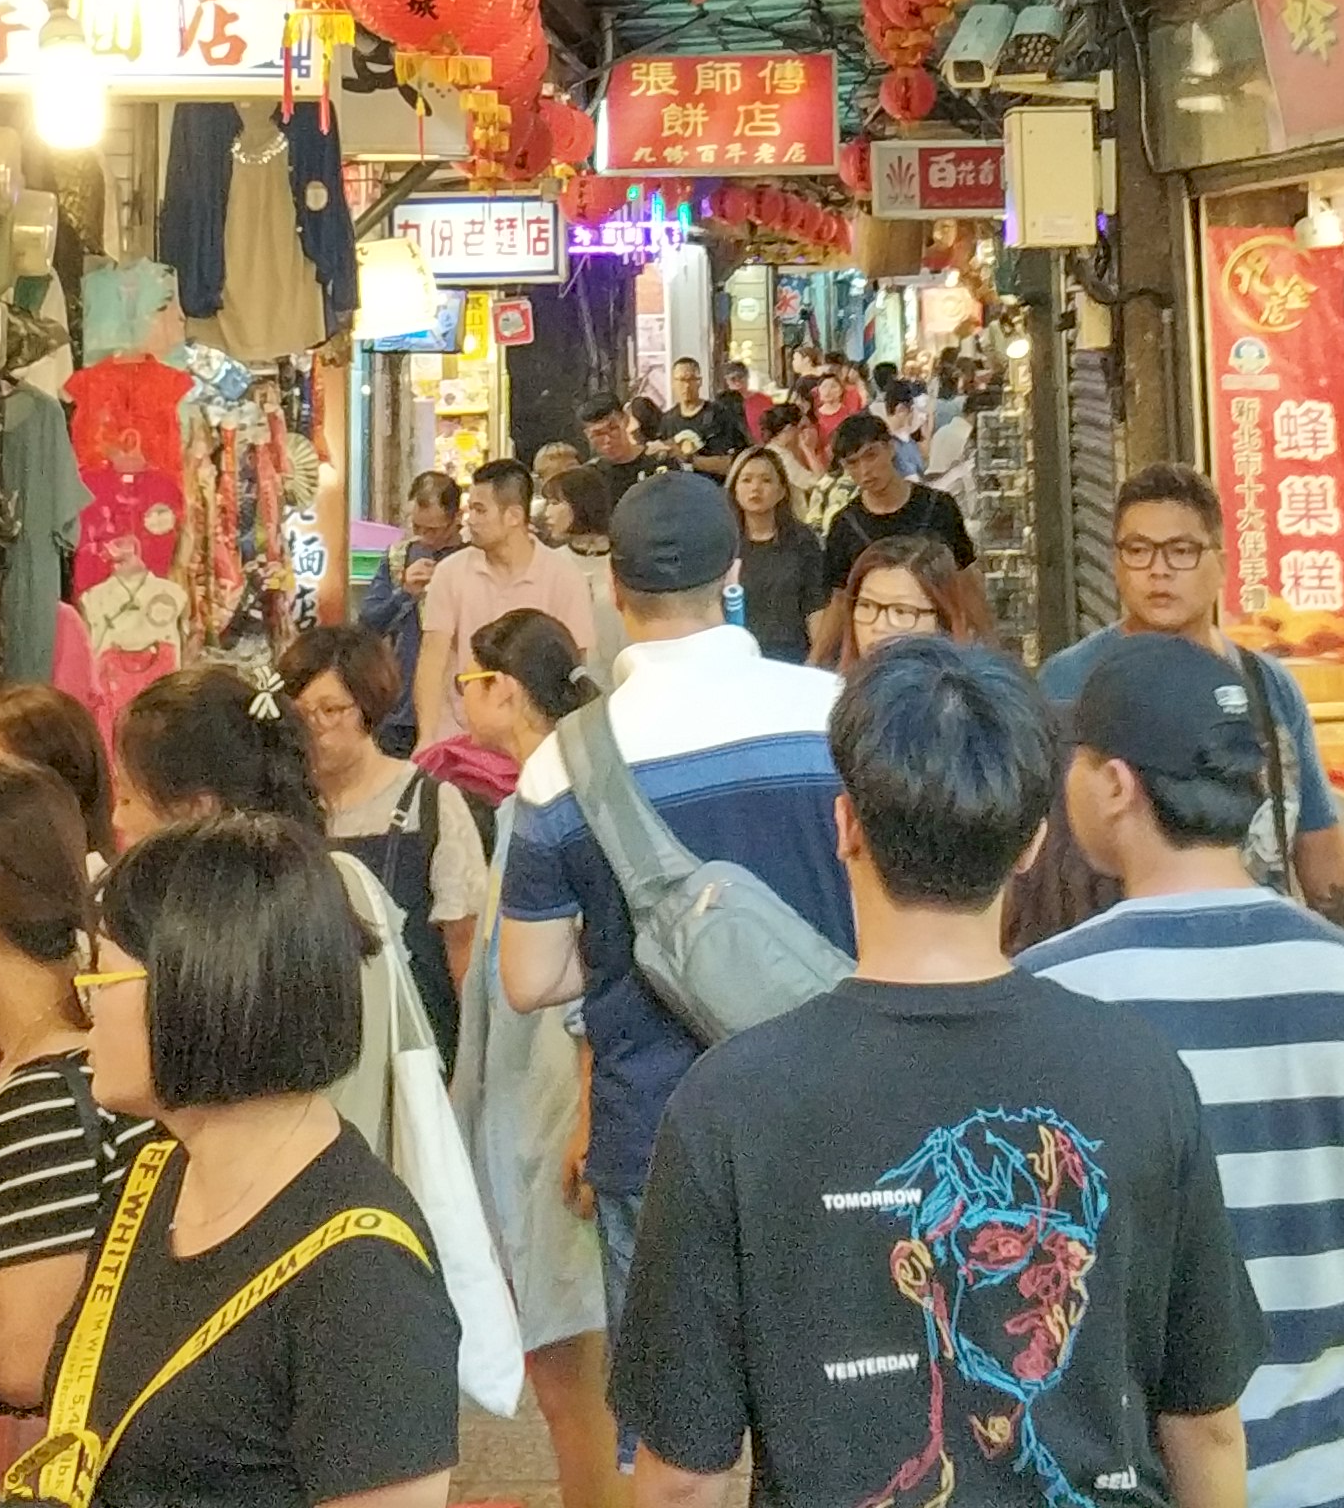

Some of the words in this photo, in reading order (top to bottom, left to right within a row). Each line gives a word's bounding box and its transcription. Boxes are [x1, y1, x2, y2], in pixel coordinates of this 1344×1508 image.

[630, 59, 807, 97] 張師傅
[660, 100, 782, 138] 餅店
[1273, 401, 1344, 612] 蜂巢糕
[822, 1187, 923, 1212] TOMORROW
[824, 1352, 920, 1382] YESTERDAY
